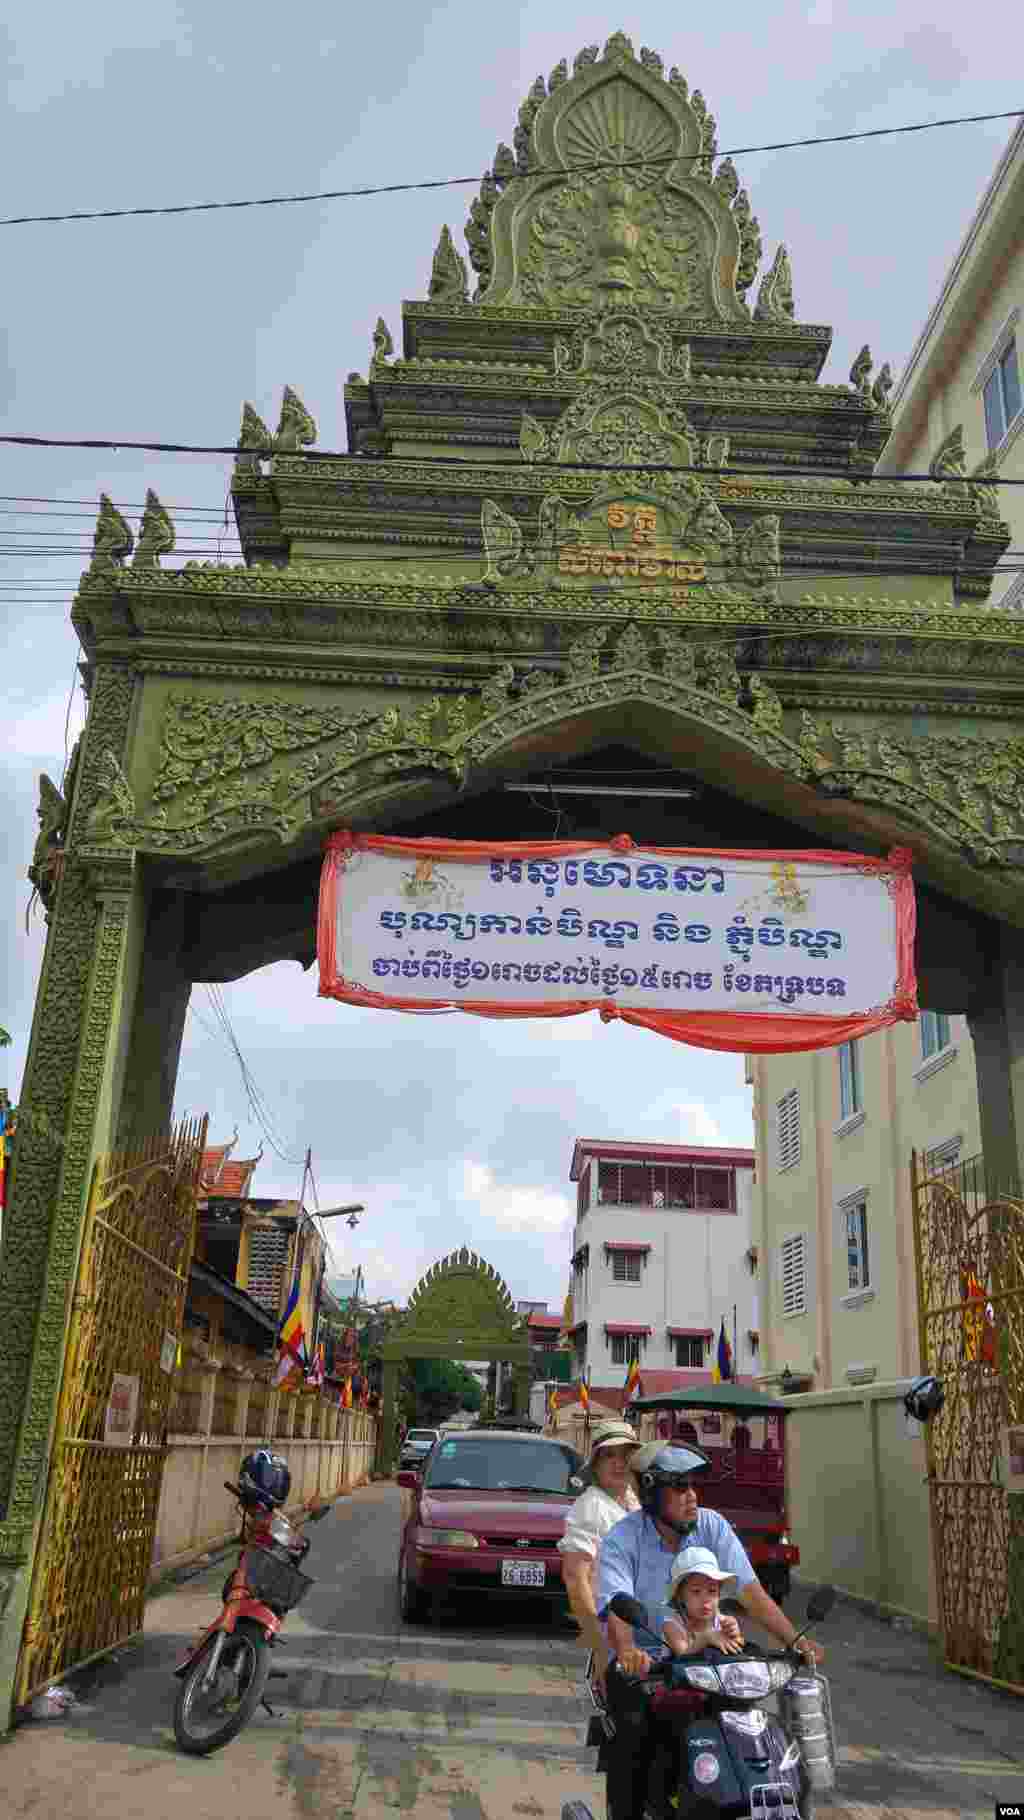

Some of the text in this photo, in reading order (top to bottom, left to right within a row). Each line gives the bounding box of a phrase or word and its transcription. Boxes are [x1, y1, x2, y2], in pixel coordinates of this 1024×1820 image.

[489, 858, 725, 897] អនុមោទនា
[653, 912, 712, 943] និង
[726, 915, 842, 962] ភ្ជុំបិណ្ឌ
